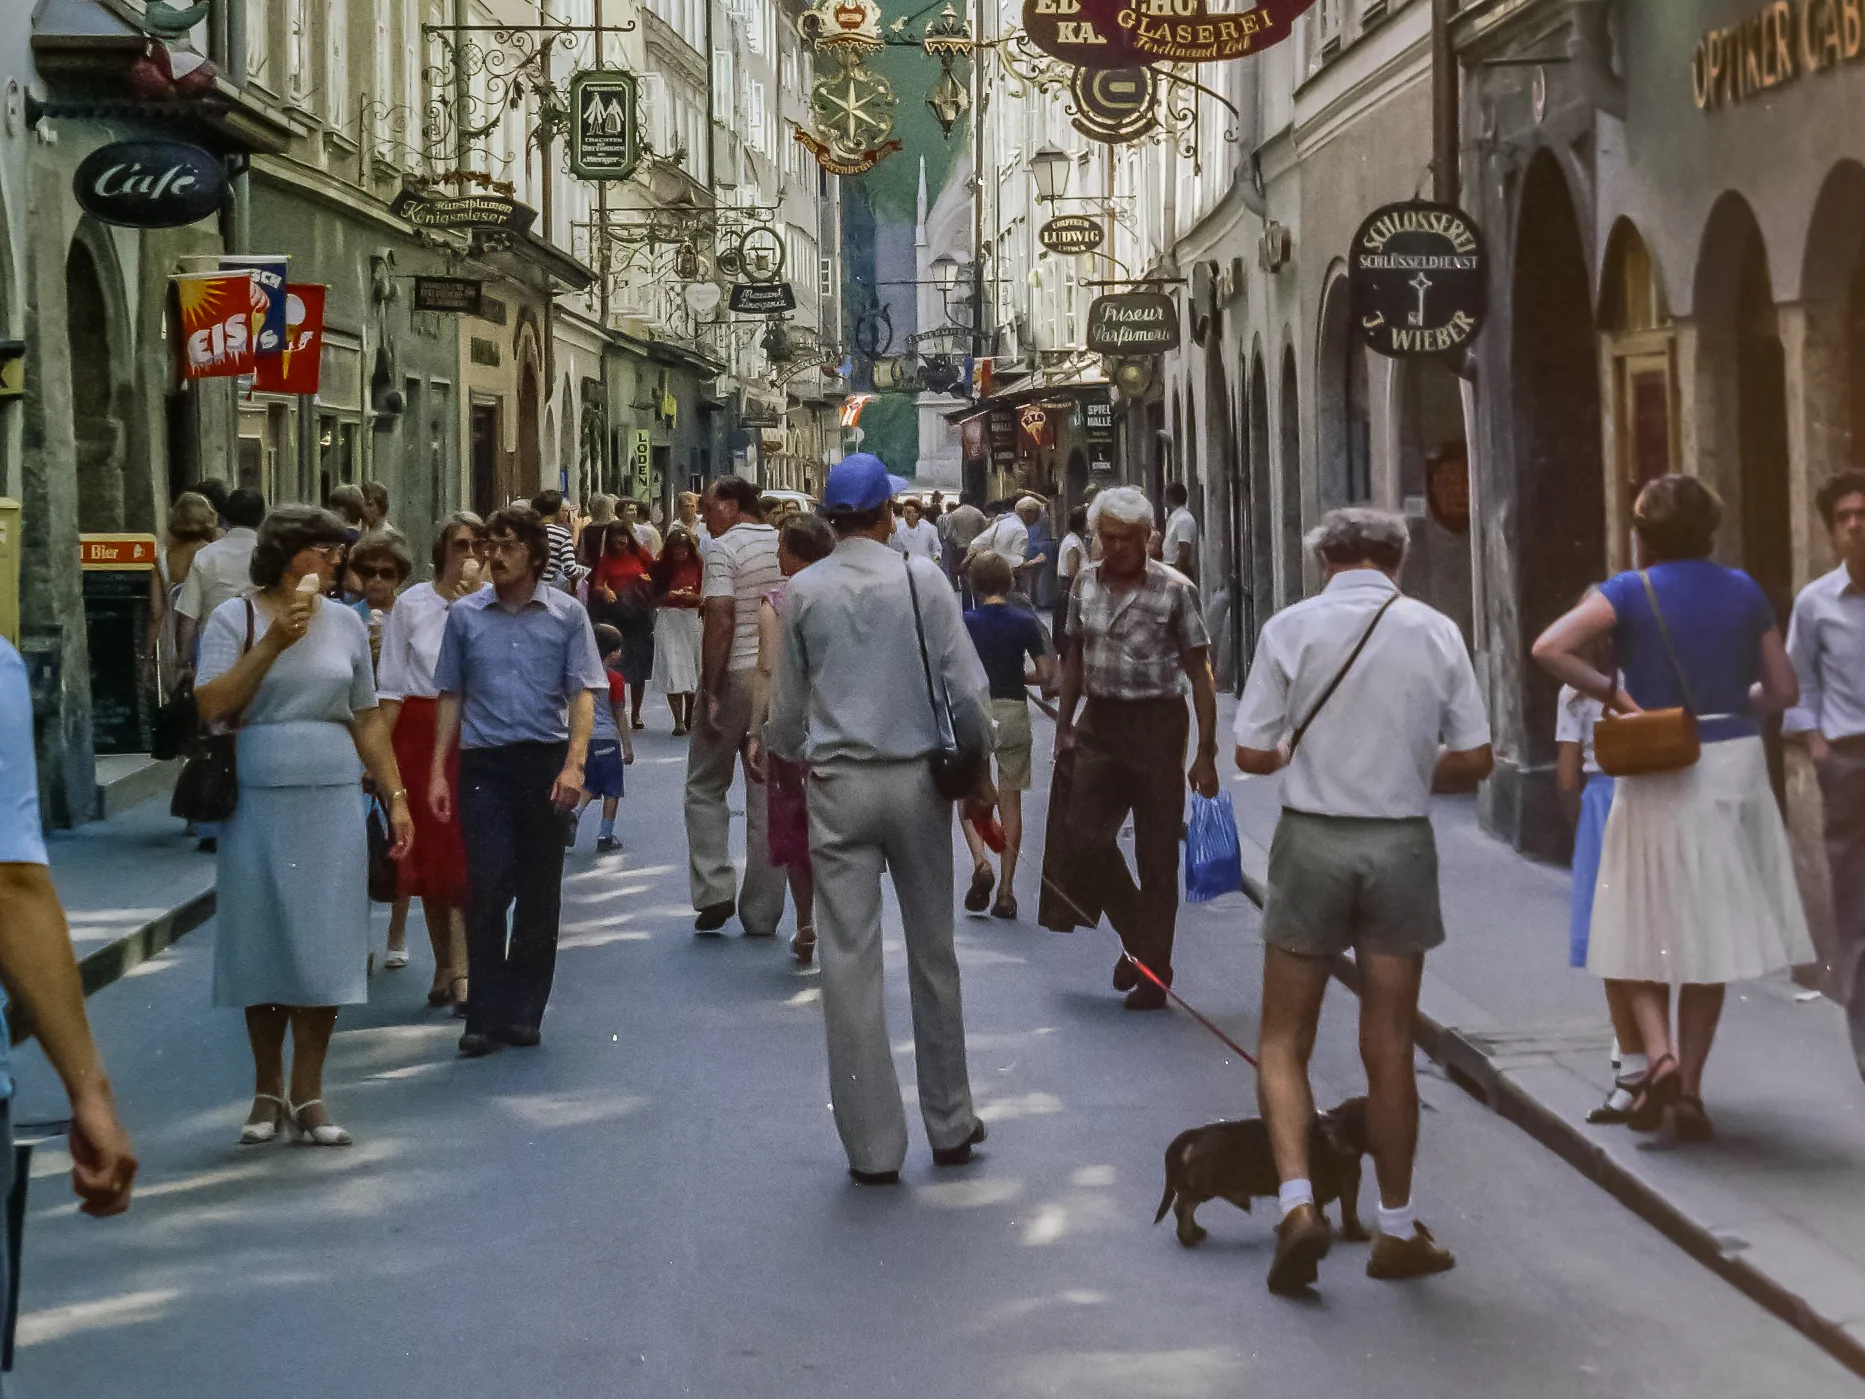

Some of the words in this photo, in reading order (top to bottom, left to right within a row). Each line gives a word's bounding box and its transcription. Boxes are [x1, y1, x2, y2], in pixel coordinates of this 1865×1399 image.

[1116, 8, 1273, 44] GLASEREI
[1692, 0, 1793, 109] OPTIKER
[1043, 230, 1099, 243] LUDWIG
[1362, 211, 1477, 253] SCHLOSSEREI
[1359, 252, 1478, 269] SCHLÜSSELDIENST
[1100, 302, 1165, 322] Friseur
[1390, 309, 1476, 352] WIEBER
[187, 313, 248, 369] EIS
[1022, 411, 1046, 424] EIS
[1087, 404, 1111, 415] SPIEL
[1087, 416, 1112, 427] HALLE
[637, 432, 647, 487] LODEN
[91, 544, 119, 560] Bier
